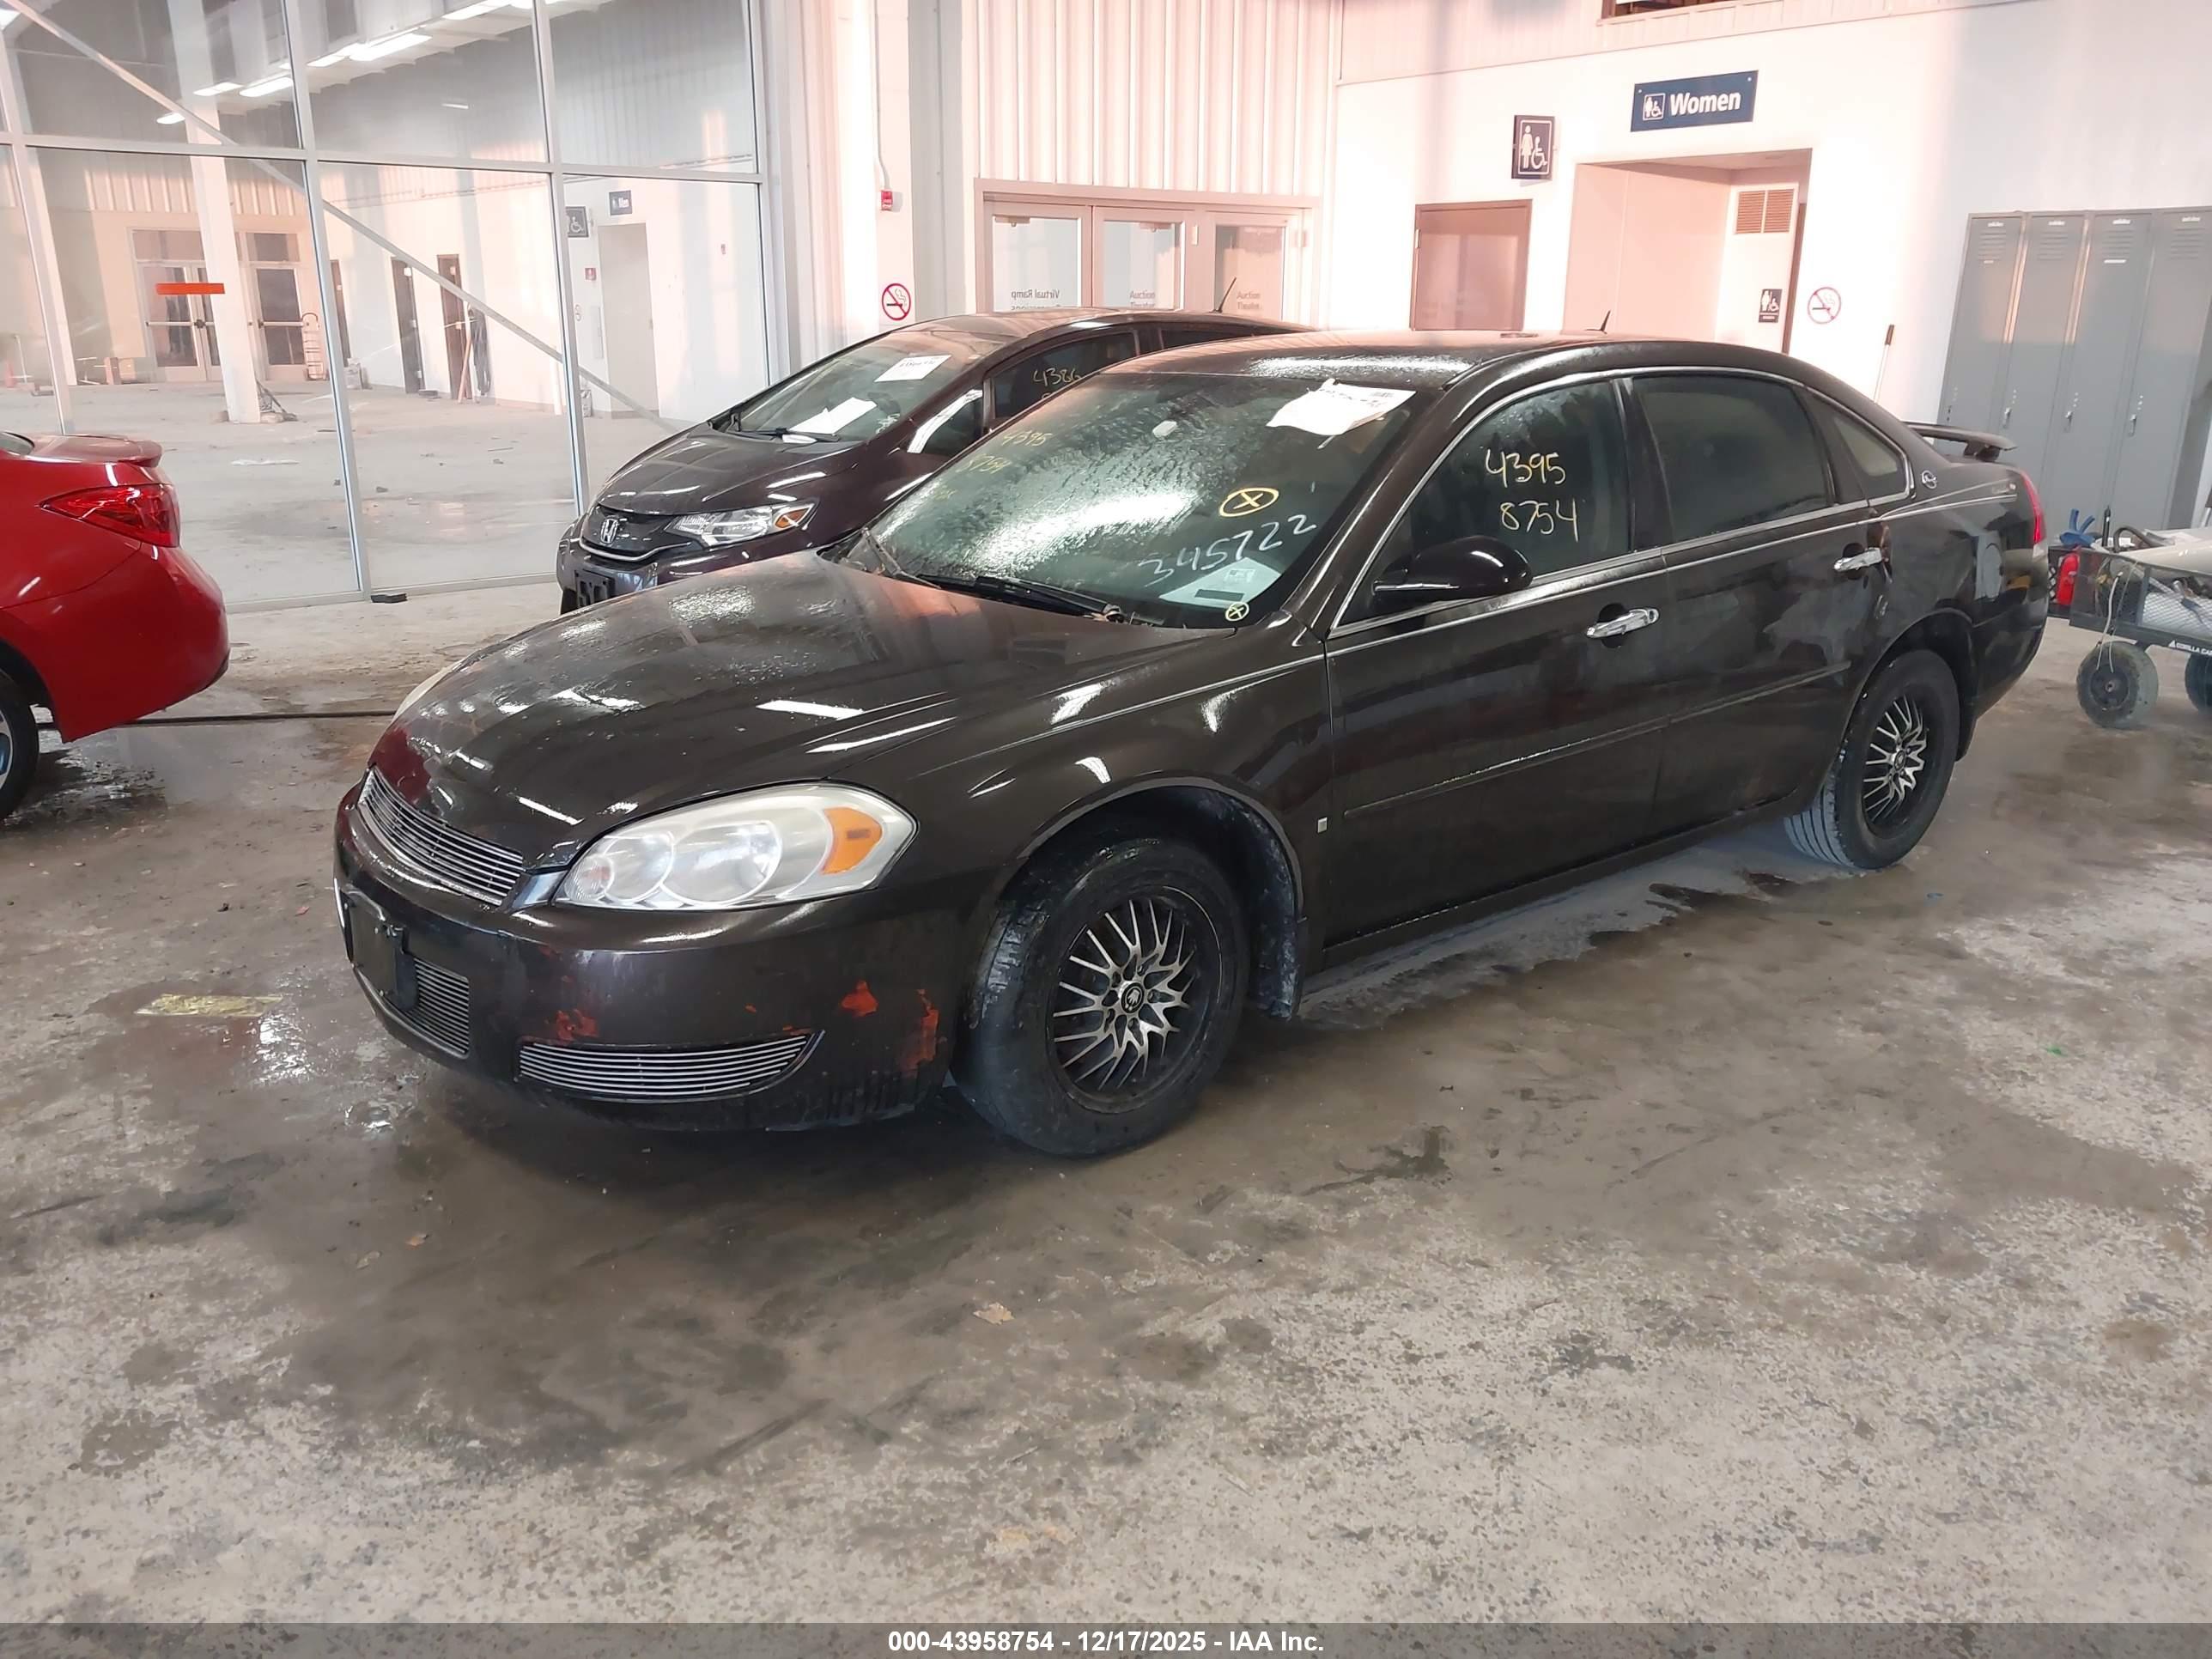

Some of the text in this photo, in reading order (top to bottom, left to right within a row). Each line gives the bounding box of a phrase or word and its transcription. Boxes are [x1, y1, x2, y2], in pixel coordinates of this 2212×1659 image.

[1669, 92, 1741, 117] Women
[1033, 367, 1082, 386] 4386
[1485, 448, 1566, 488] 4395
[1499, 497, 1578, 543] 8754
[1138, 514, 1317, 587] 345722
